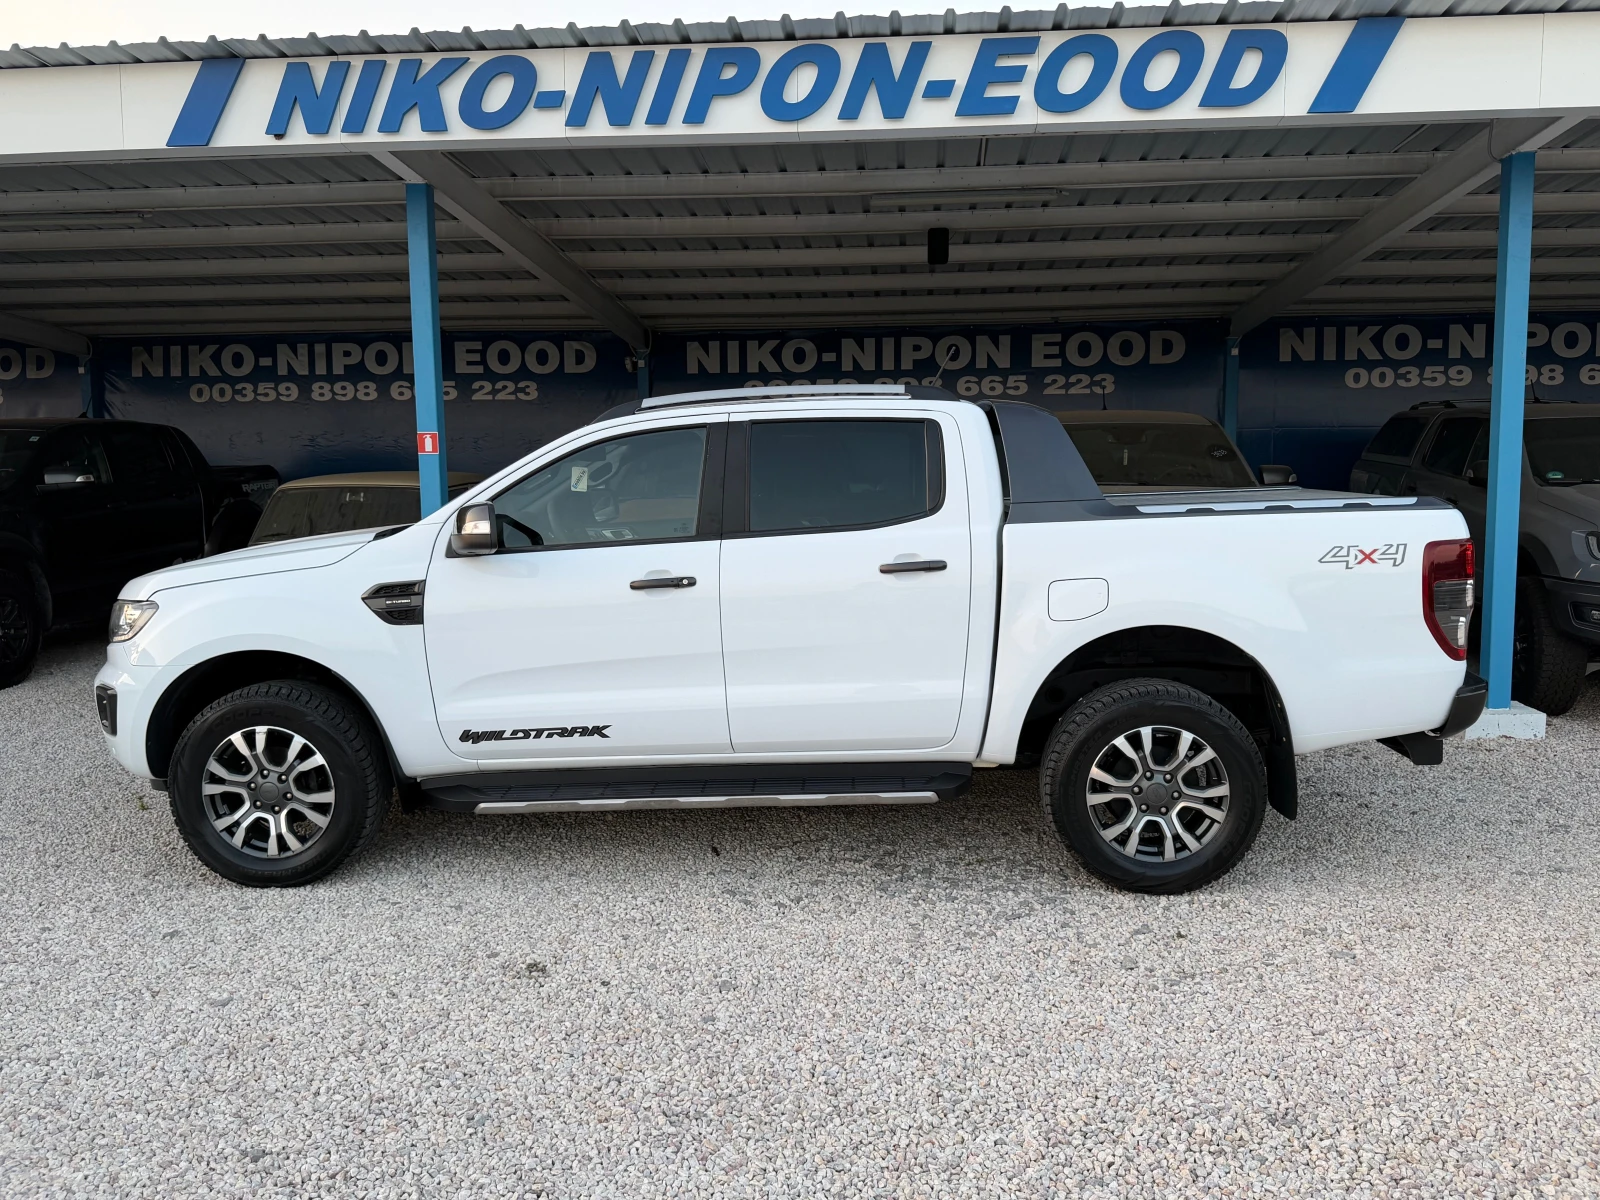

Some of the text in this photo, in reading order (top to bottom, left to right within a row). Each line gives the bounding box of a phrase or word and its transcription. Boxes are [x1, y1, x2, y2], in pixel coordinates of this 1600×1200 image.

[265, 28, 1289, 136] NIKO-NIPON-EOOD
[686, 330, 1186, 374] NIKO-NIPON EOOD
[1278, 322, 1600, 362] NIKO-NPO
[454, 340, 597, 375] EOOD
[956, 374, 1028, 396] 665
[1042, 373, 1116, 395] 223
[1344, 365, 1473, 388] 00359
[1487, 363, 1565, 387] 98
[189, 380, 539, 403] 00359 898 65 223
[458, 724, 613, 744] WILDTRAK
